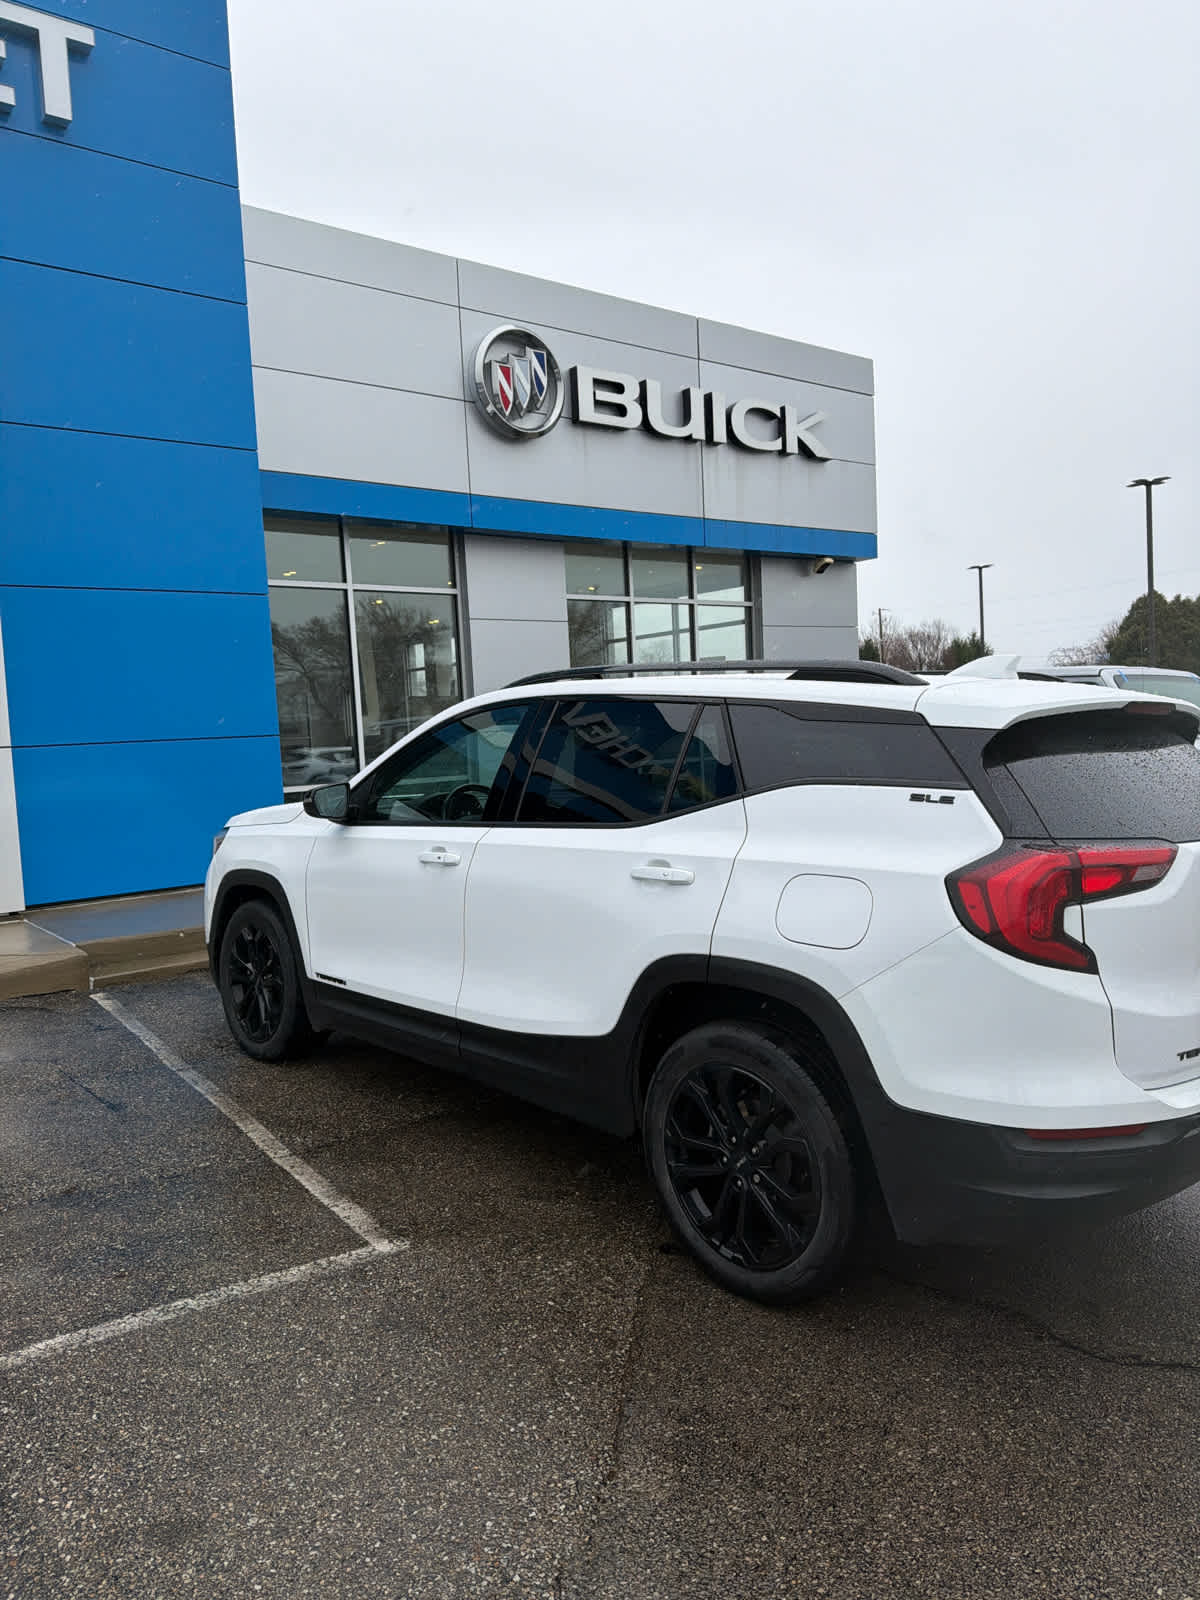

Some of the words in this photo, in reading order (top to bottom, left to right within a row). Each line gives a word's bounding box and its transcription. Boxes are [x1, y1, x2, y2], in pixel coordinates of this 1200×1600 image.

[0, 1, 95, 126] T
[571, 365, 832, 461] BUICK
[909, 793, 955, 805] SLE
